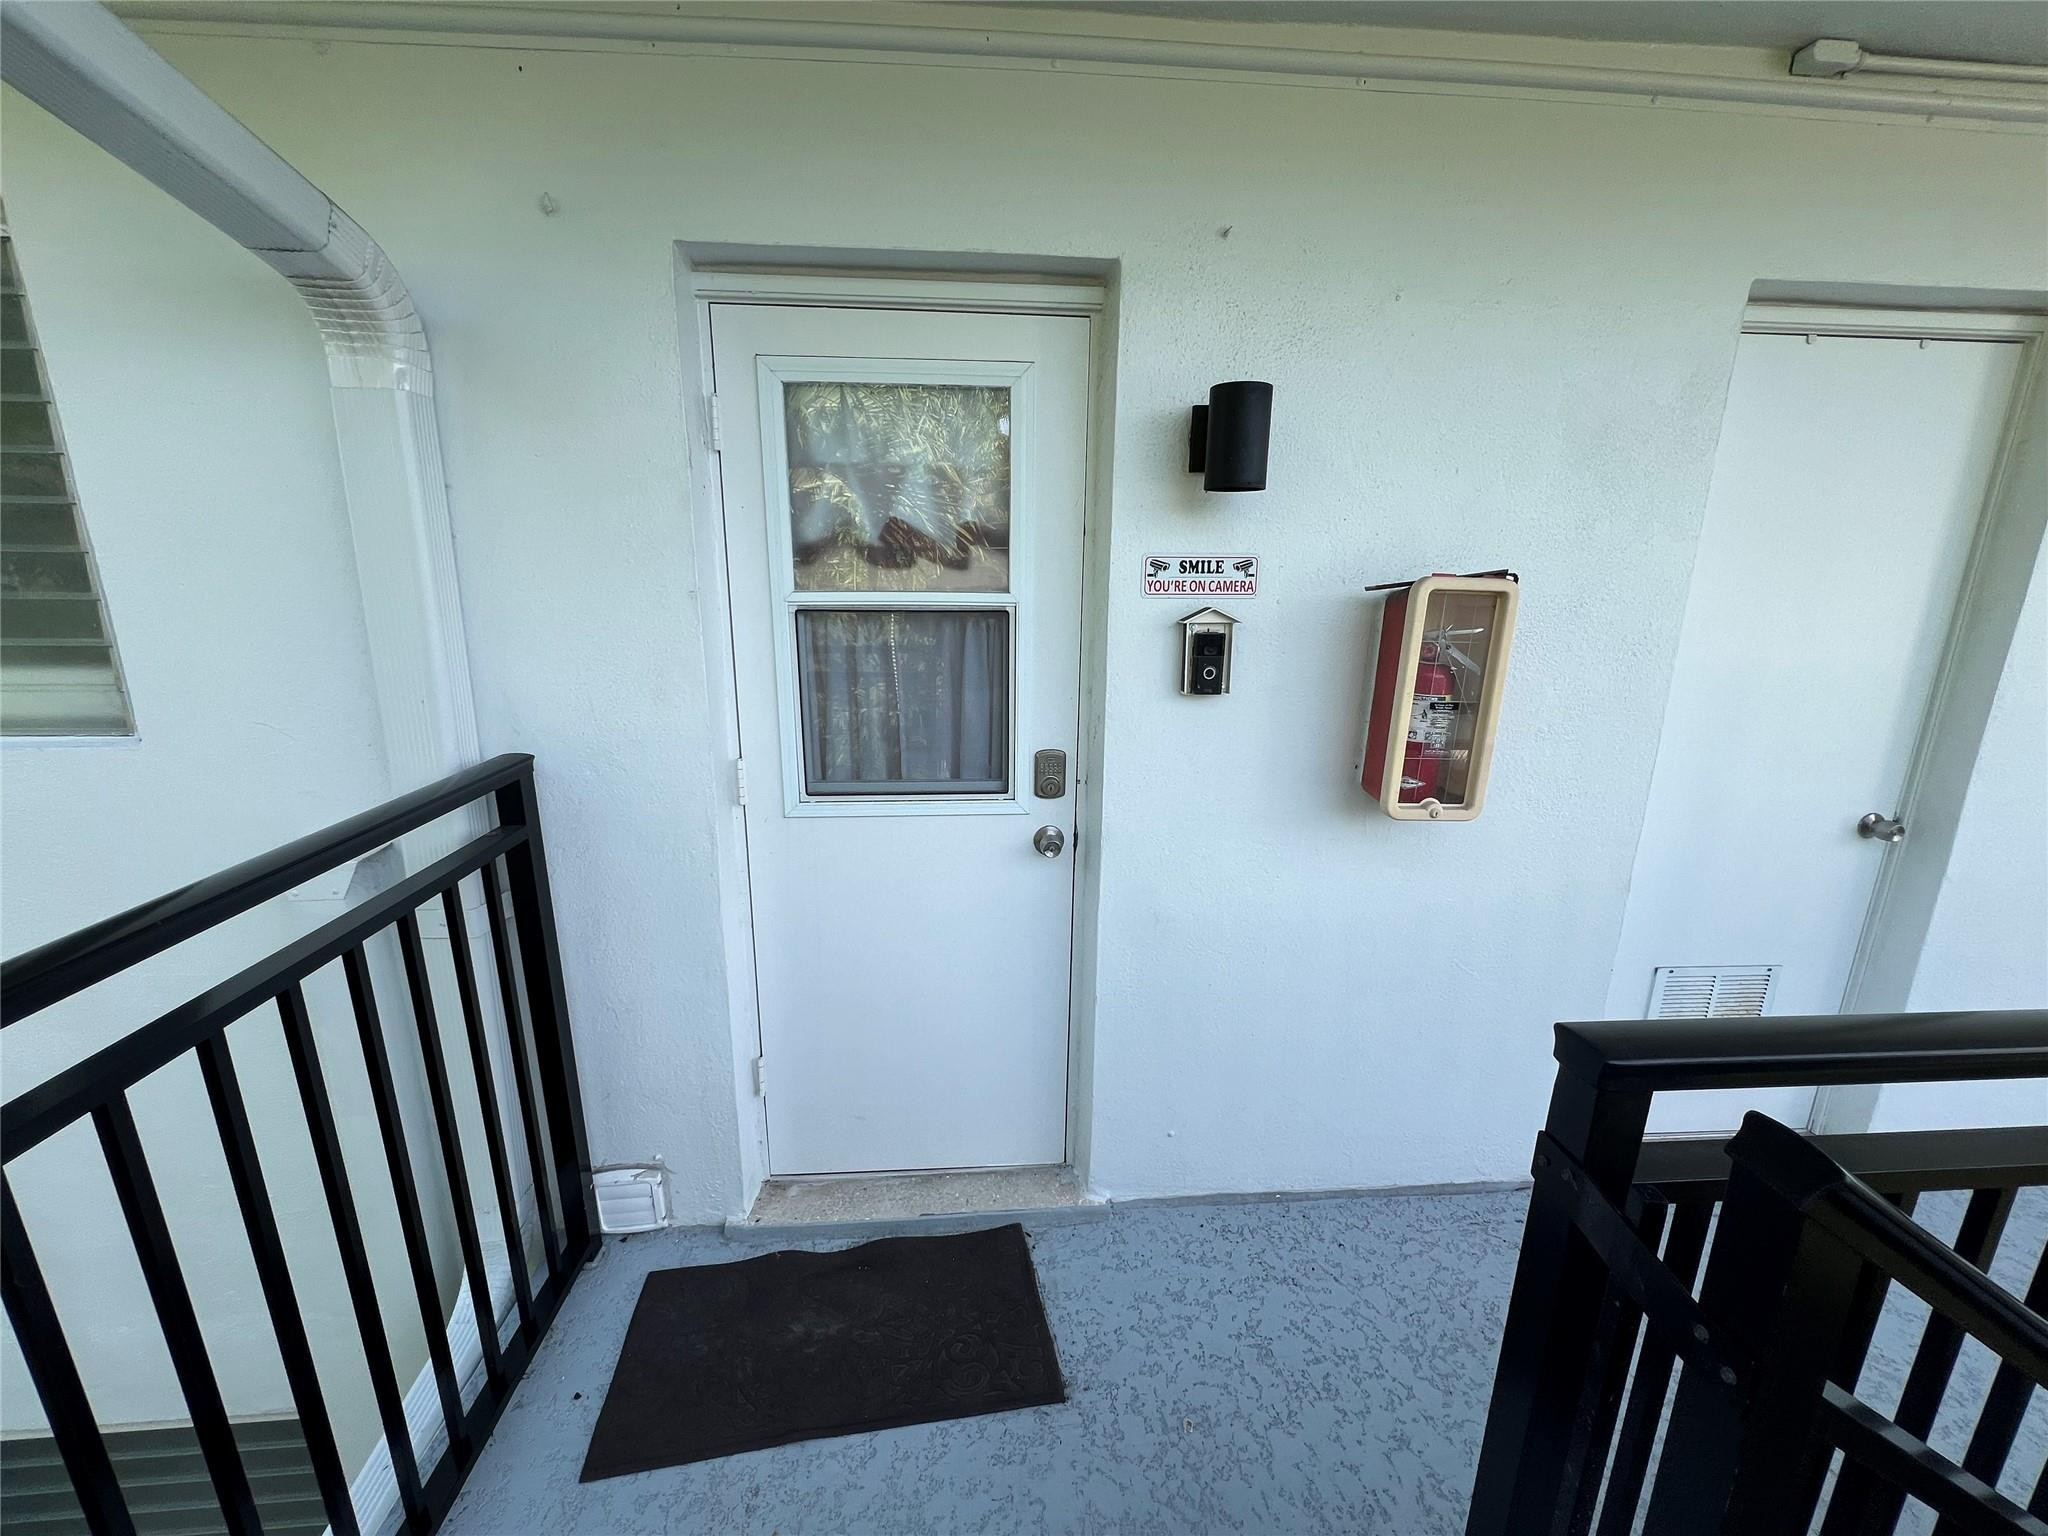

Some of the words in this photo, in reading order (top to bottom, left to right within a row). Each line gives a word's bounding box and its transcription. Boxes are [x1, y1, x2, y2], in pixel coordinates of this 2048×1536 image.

[1179, 560, 1225, 574] SMILE
[1147, 580, 1187, 592] YOU'RE
[1189, 580, 1206, 592] ON
[1208, 580, 1254, 592] CAMERA
